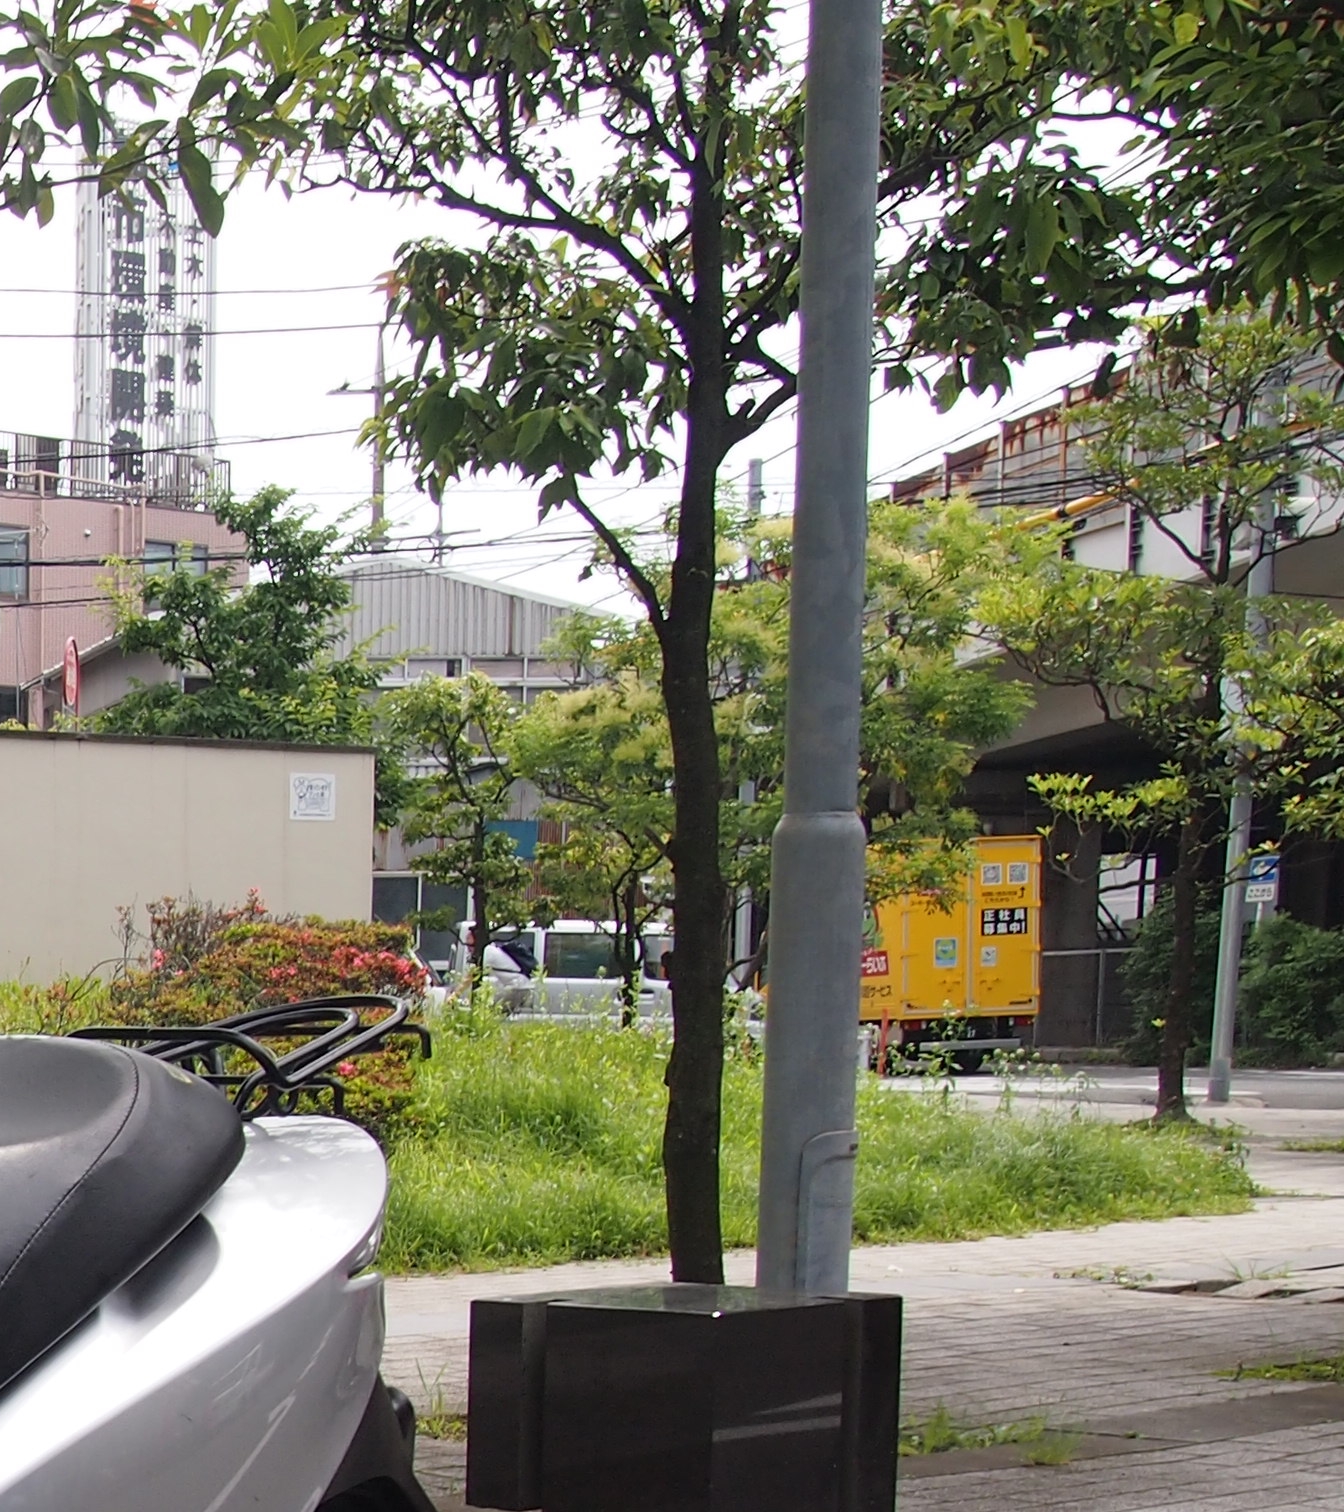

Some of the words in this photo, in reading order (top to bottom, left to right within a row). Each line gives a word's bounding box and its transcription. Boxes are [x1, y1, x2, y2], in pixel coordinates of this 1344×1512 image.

[109, 136, 147, 482] 市環境開発
